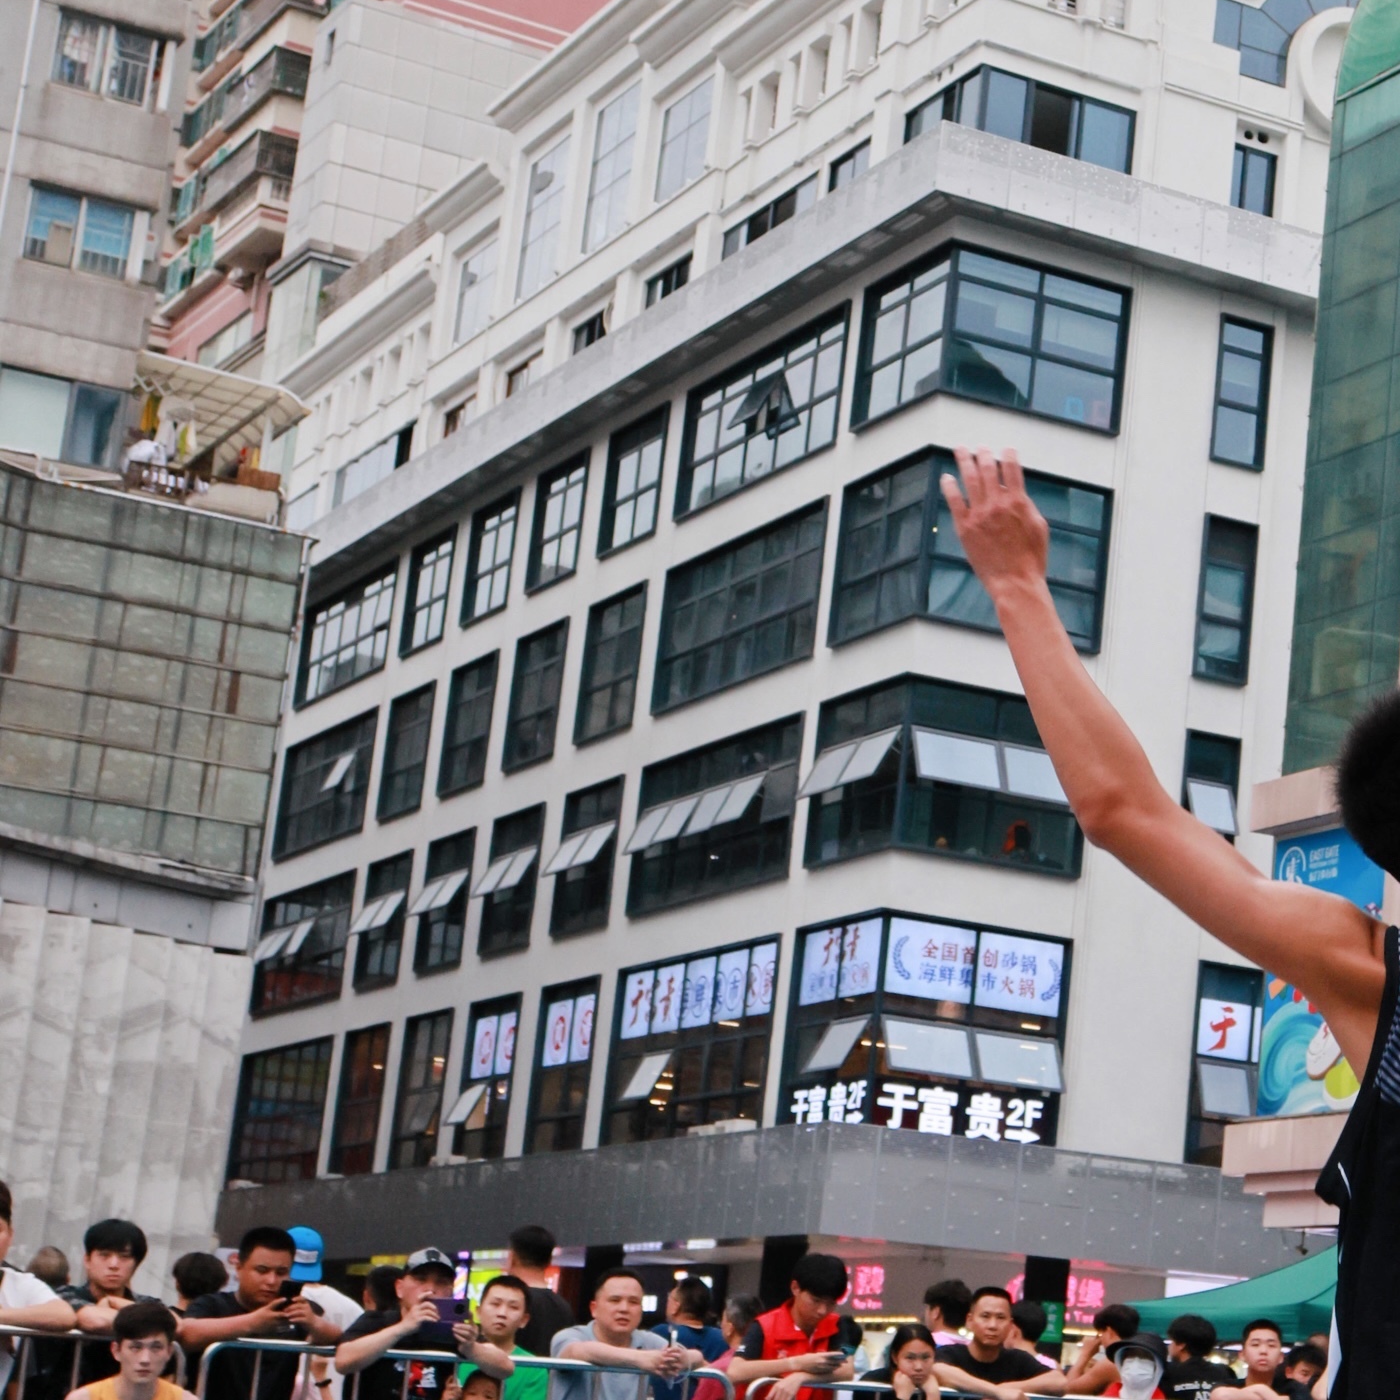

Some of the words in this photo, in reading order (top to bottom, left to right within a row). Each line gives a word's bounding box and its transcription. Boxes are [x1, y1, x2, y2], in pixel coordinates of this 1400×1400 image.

[877, 1083, 1004, 1142] 于富贵
[1005, 1099, 1044, 1129] 2F
